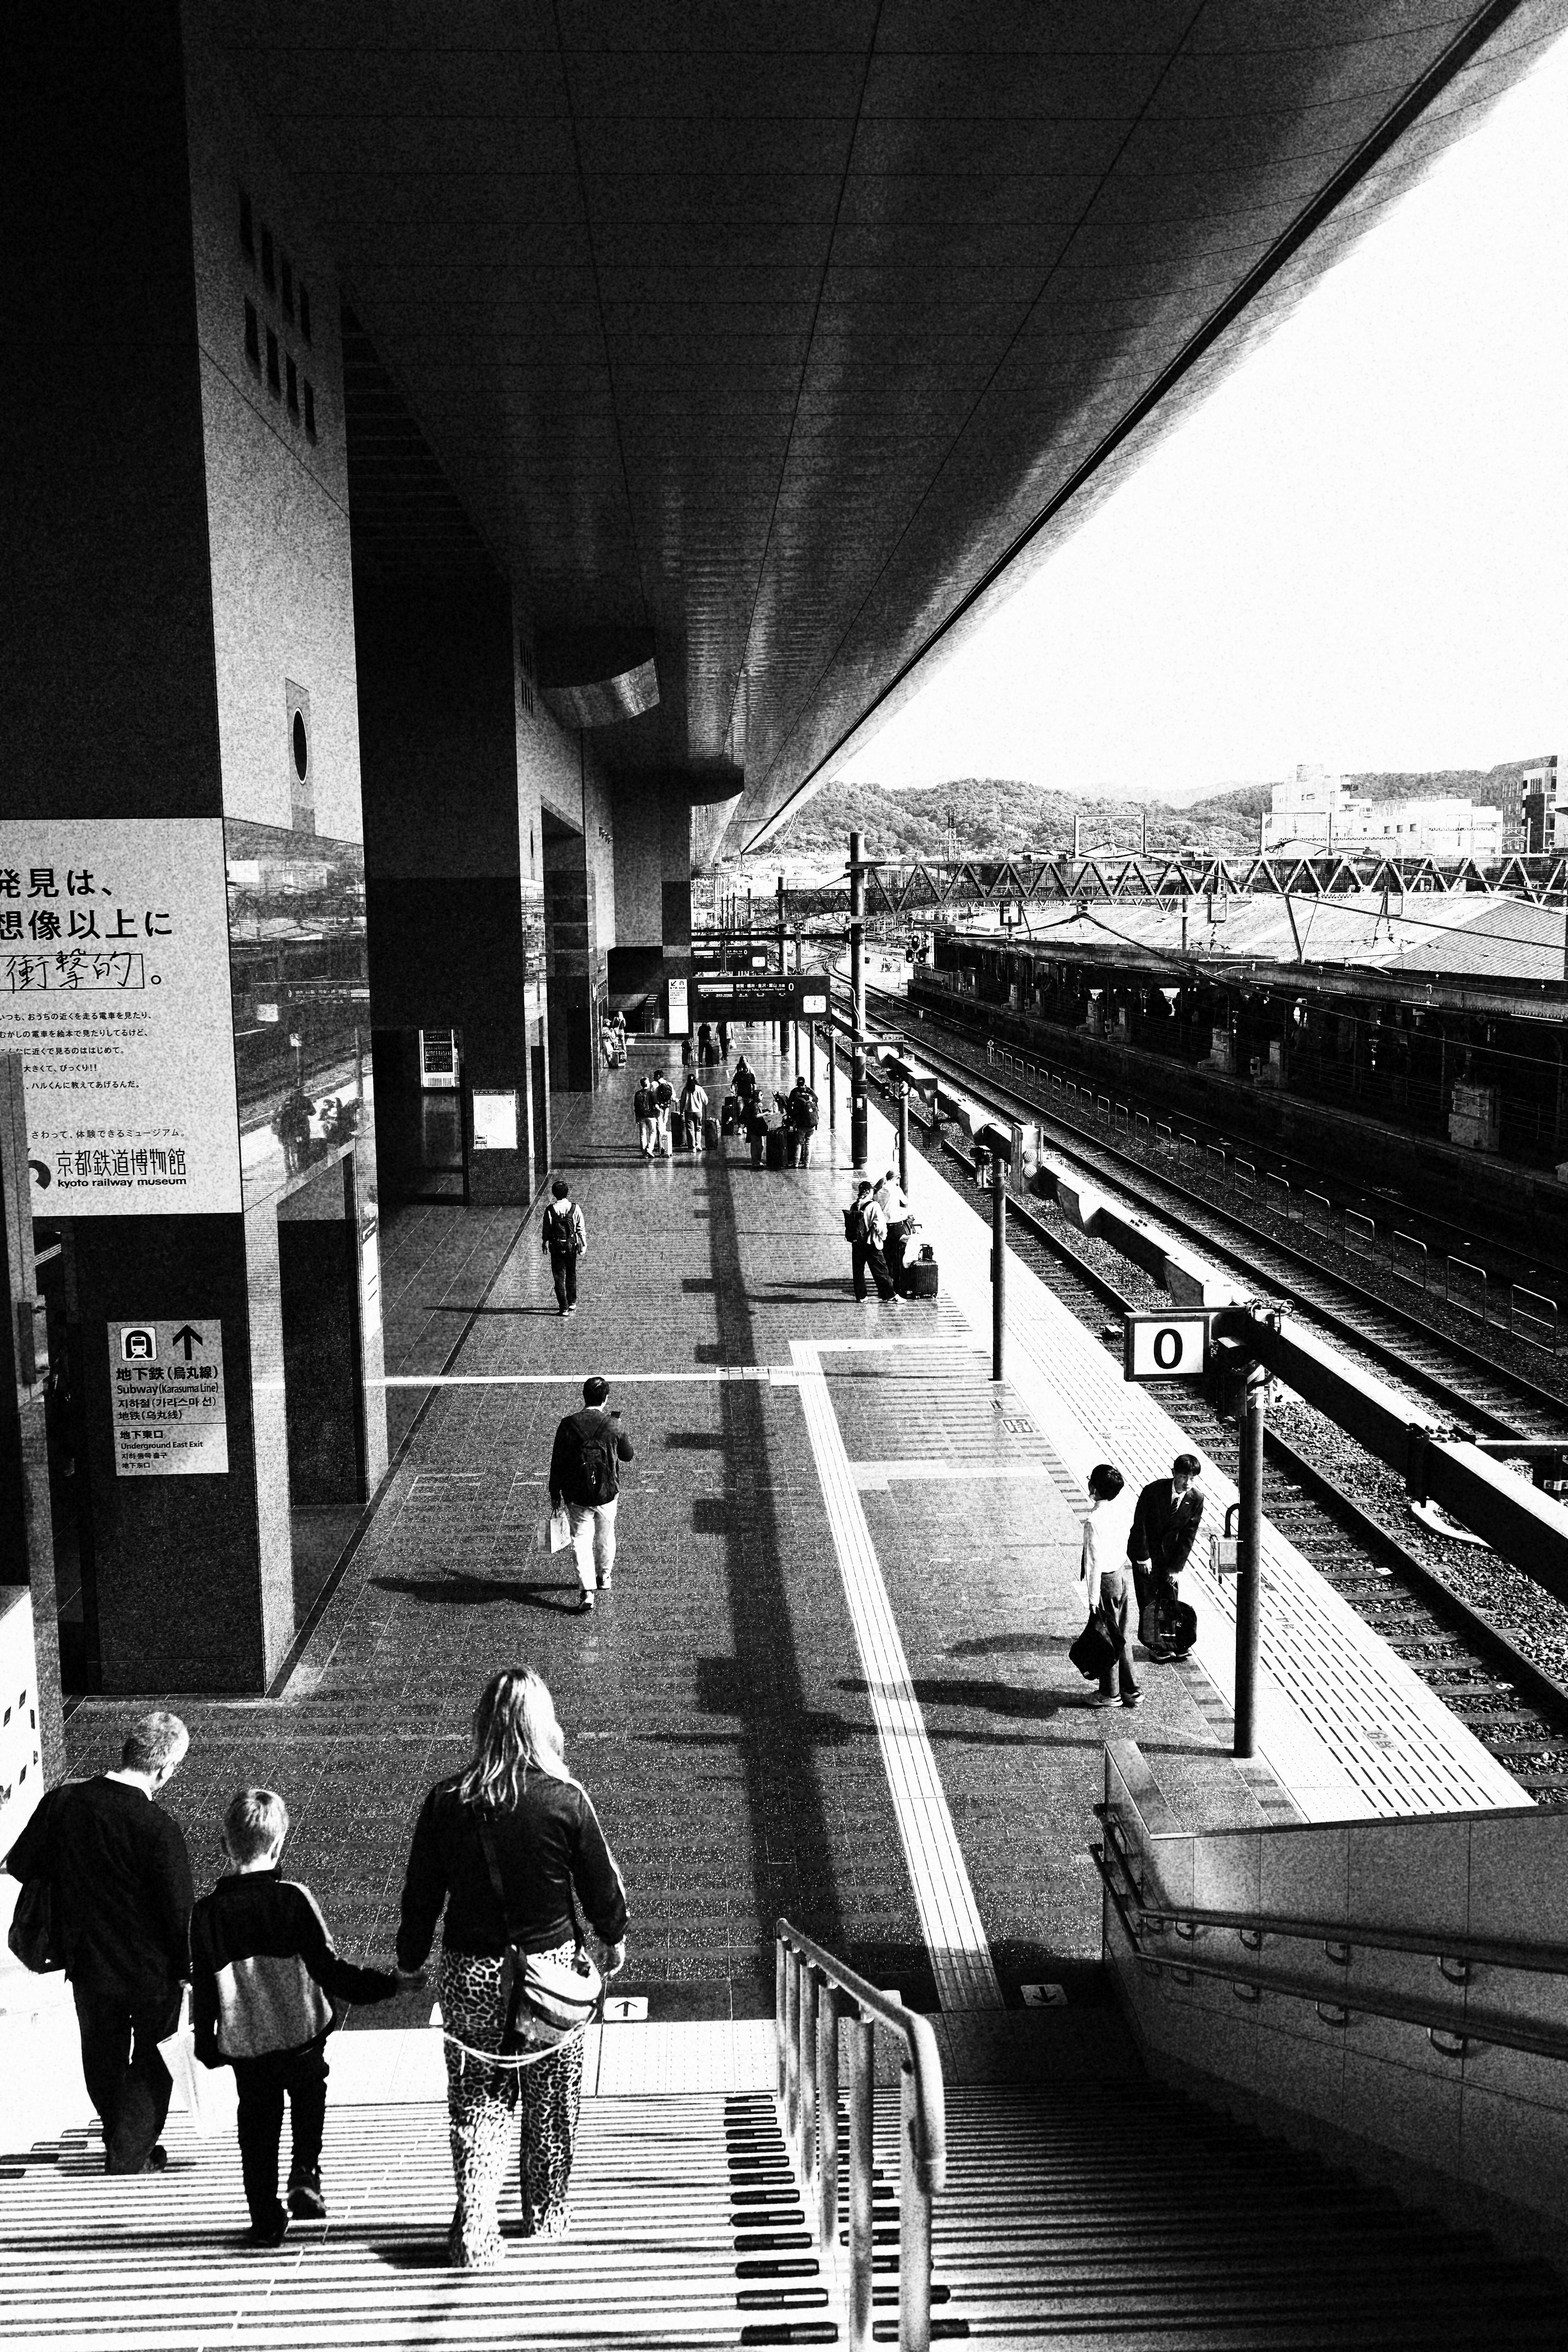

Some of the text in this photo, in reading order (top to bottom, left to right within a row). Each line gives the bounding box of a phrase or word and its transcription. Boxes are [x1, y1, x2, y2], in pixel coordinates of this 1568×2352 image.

[0, 868, 112, 898] 発見は、
[0, 909, 172, 940] 想像以上に
[788, 983, 794, 991] 0
[23, 1081, 139, 1090] 、ハルくんに教えてあげるんだ。
[56, 1148, 186, 1177] 京都鉄道博物館
[58, 1179, 89, 1188] kyoto
[92, 1178, 133, 1187] railway
[1153, 1328, 1183, 1369] 0
[200, 1382, 218, 1393] Line)
[120, 1430, 163, 1440] 地下東口
[121, 1441, 171, 1450] Underground
